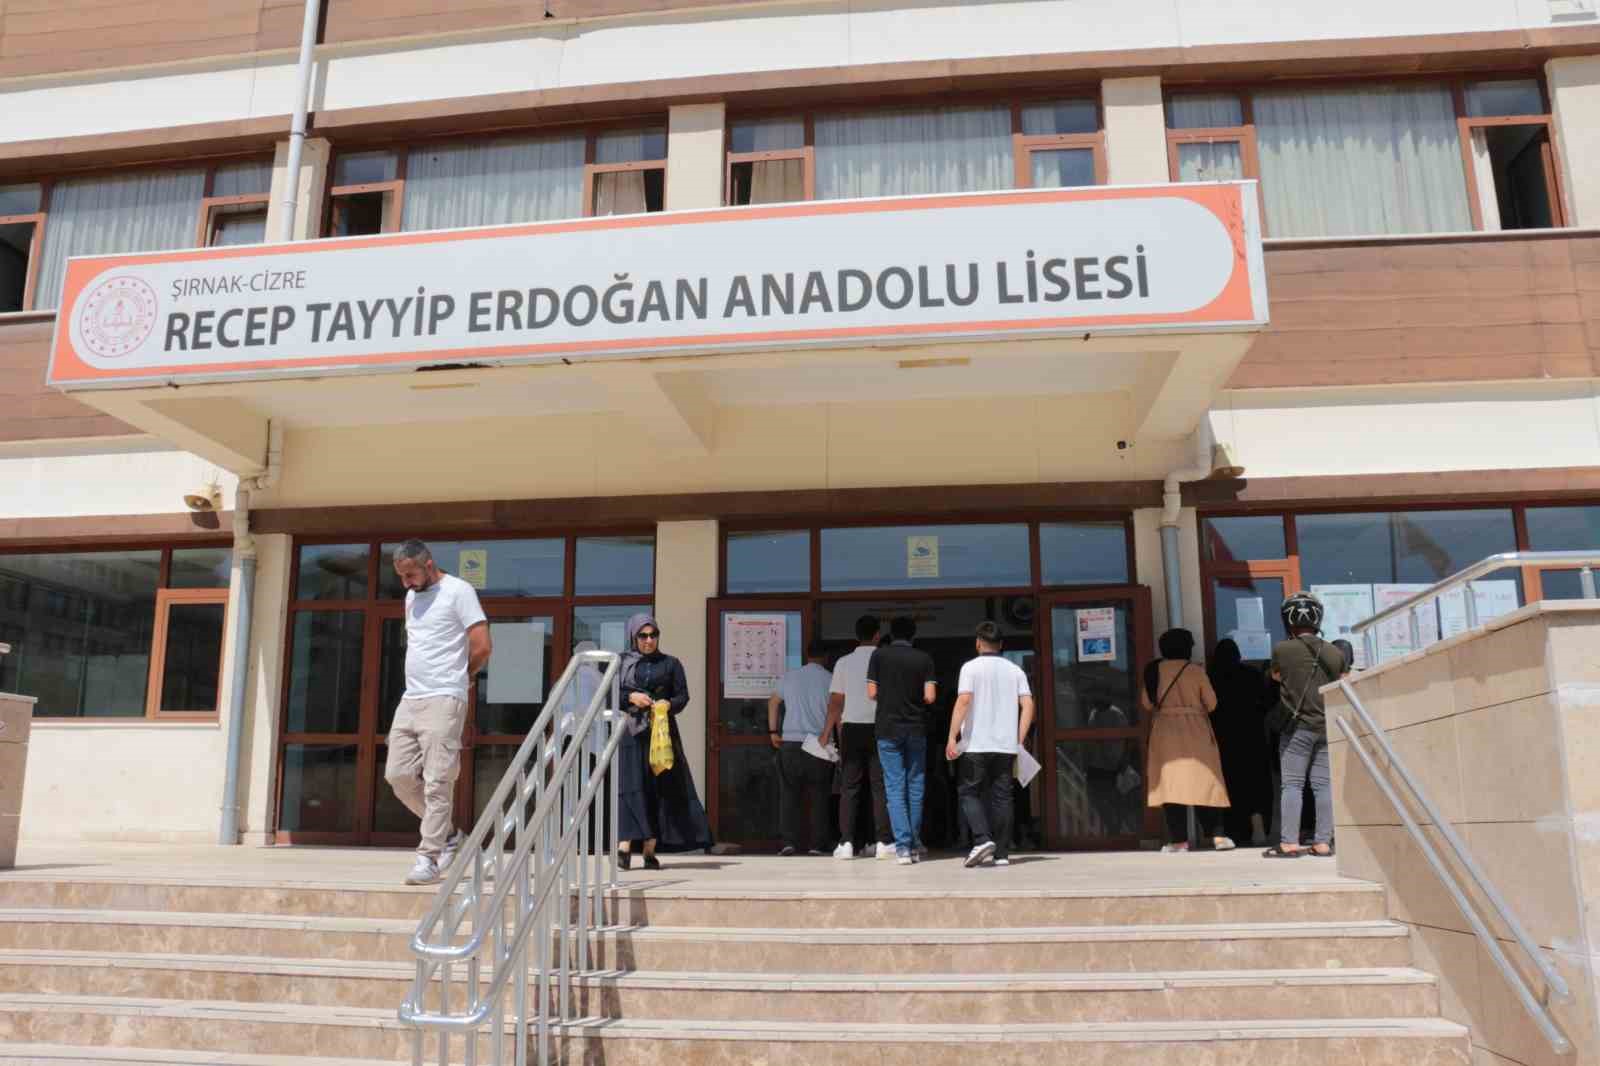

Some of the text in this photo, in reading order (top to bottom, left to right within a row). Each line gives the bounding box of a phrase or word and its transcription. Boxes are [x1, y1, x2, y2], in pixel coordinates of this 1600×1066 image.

[164, 306, 295, 352] RECEP
[306, 285, 456, 343] TAYYİP
[467, 272, 708, 333] ERDOĞAN
[722, 262, 980, 319] ANADOLU
[996, 244, 1149, 305] LİSESİ
[171, 270, 306, 300] ŞIRNAK-CİZRE
